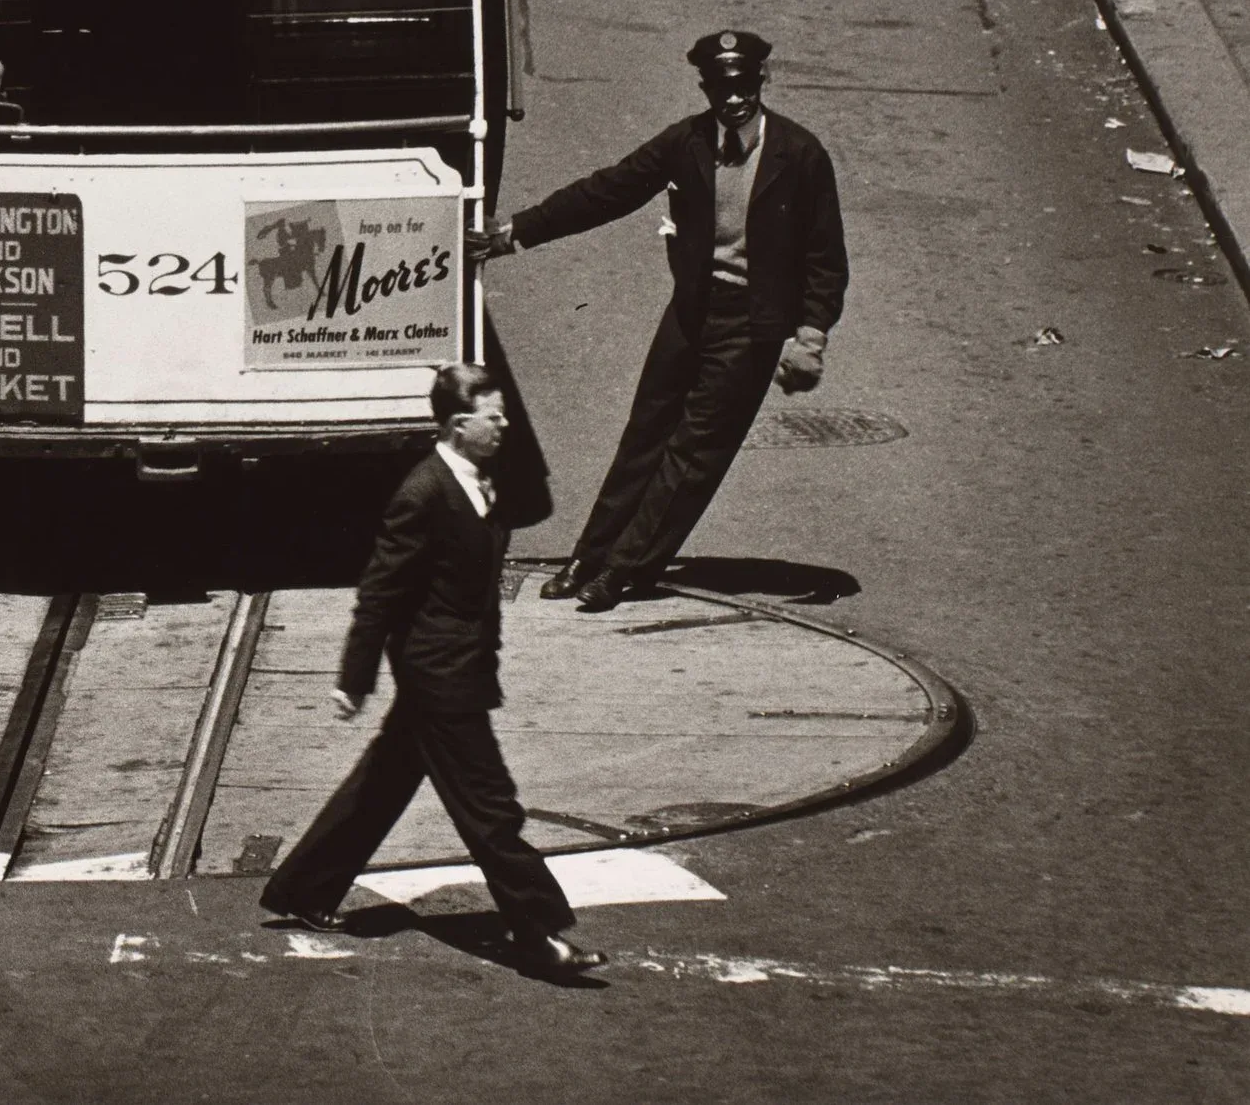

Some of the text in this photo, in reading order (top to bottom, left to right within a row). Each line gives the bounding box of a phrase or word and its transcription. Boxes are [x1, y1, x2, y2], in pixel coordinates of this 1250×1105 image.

[359, 217, 425, 237] hop on for
[98, 251, 238, 296] 524
[306, 241, 451, 322] Moore's
[252, 323, 449, 344] Hart Schaffner & Marx Clothes
[306, 350, 348, 359] MARKET
